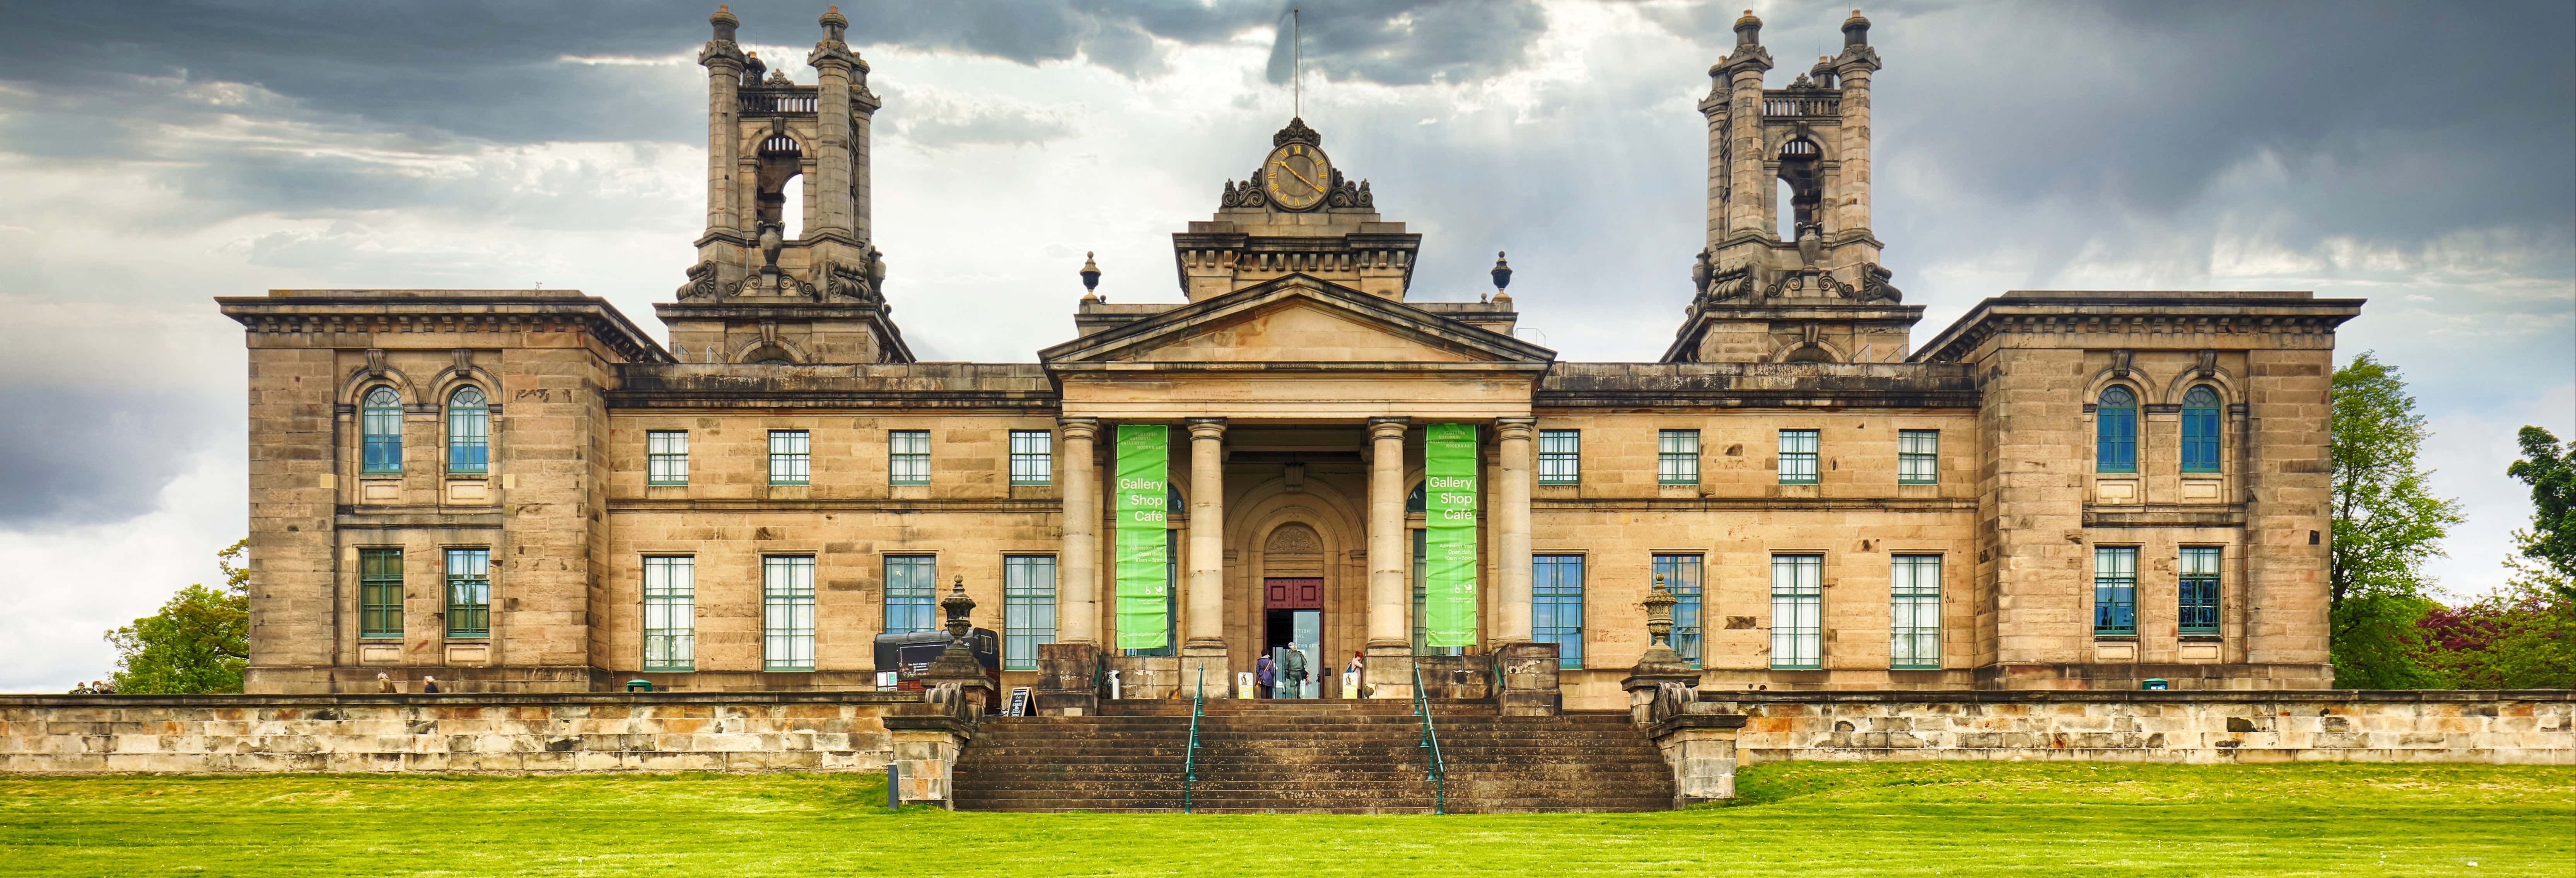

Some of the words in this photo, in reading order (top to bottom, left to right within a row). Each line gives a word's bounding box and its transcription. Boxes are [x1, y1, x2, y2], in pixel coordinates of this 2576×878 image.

[1120, 478, 1163, 492] Gallery
[1430, 476, 1472, 490] Gallery
[1131, 494, 1163, 508] Shop
[1441, 493, 1472, 506] Shop
[1135, 510, 1163, 521] Café
[1444, 509, 1472, 520] Café
